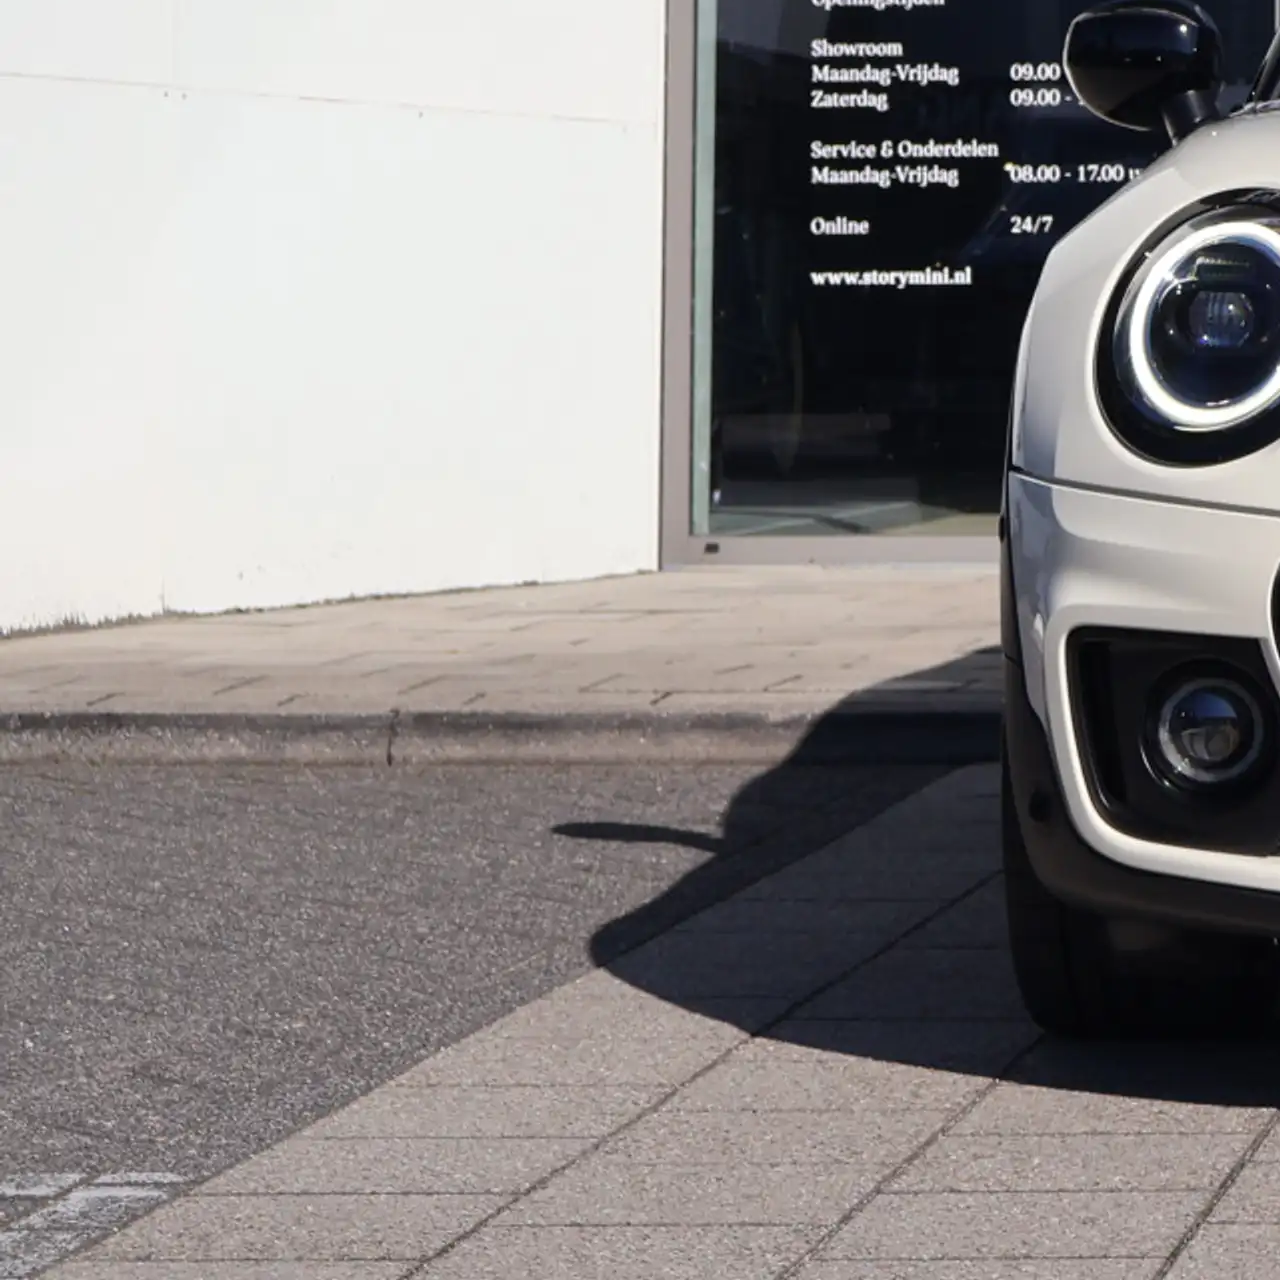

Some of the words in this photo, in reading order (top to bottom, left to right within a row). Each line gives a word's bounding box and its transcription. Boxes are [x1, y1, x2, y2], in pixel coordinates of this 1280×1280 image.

[810, 39, 903, 58] Showroom
[811, 63, 960, 87] Maandag-Vrijdag
[1010, 63, 1061, 81] 09.00
[811, 89, 889, 112] Zaterdag
[1009, 89, 1061, 107] 09.00
[810, 141, 876, 159] Service
[881, 140, 894, 158] &
[898, 139, 999, 158] Onderdelen
[811, 165, 960, 189] Maandag-Vrijdag
[1010, 165, 1061, 183] 08.00
[1077, 164, 1125, 183] 17.00
[810, 217, 869, 236] Online
[1010, 216, 1054, 234] 24/7
[810, 266, 972, 290] www.storymini.nl
